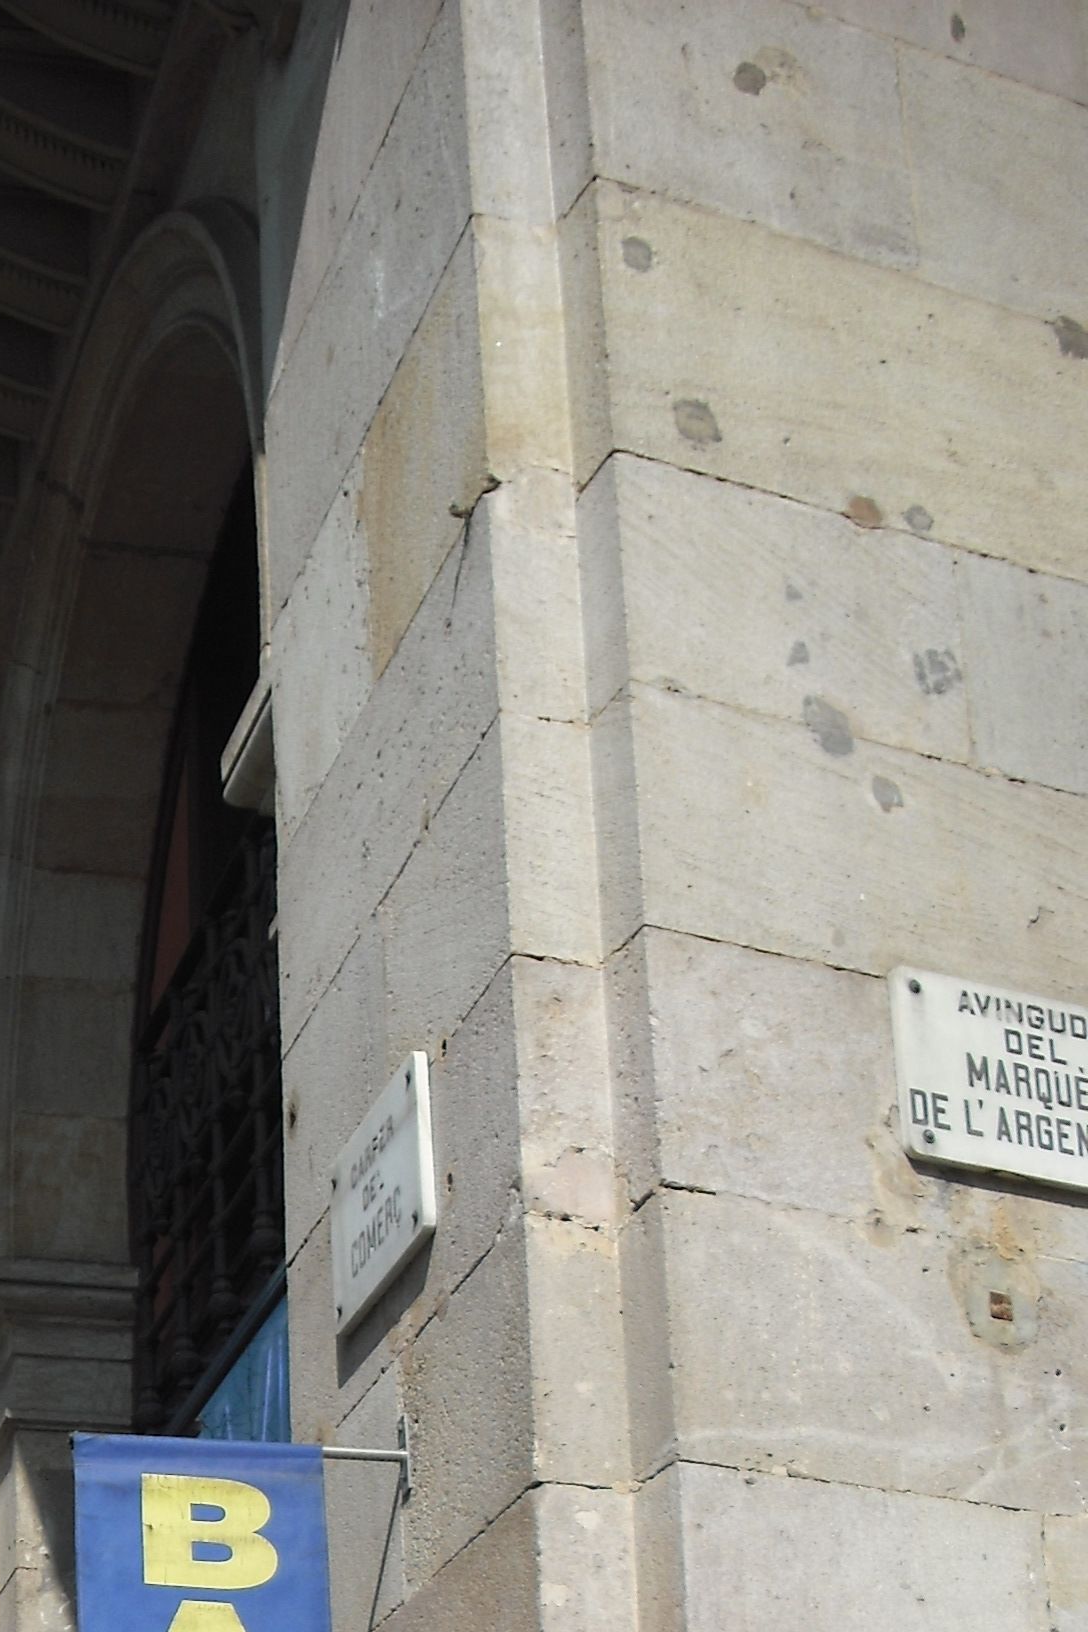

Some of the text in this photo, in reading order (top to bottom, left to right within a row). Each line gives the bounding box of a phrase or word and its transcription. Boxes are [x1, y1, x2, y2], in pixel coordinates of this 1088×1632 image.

[958, 989, 1088, 1040] AVINGUD
[1004, 1028, 1067, 1066] DEL
[909, 1087, 952, 1132] DE
[350, 1184, 403, 1279] COMERÇ
